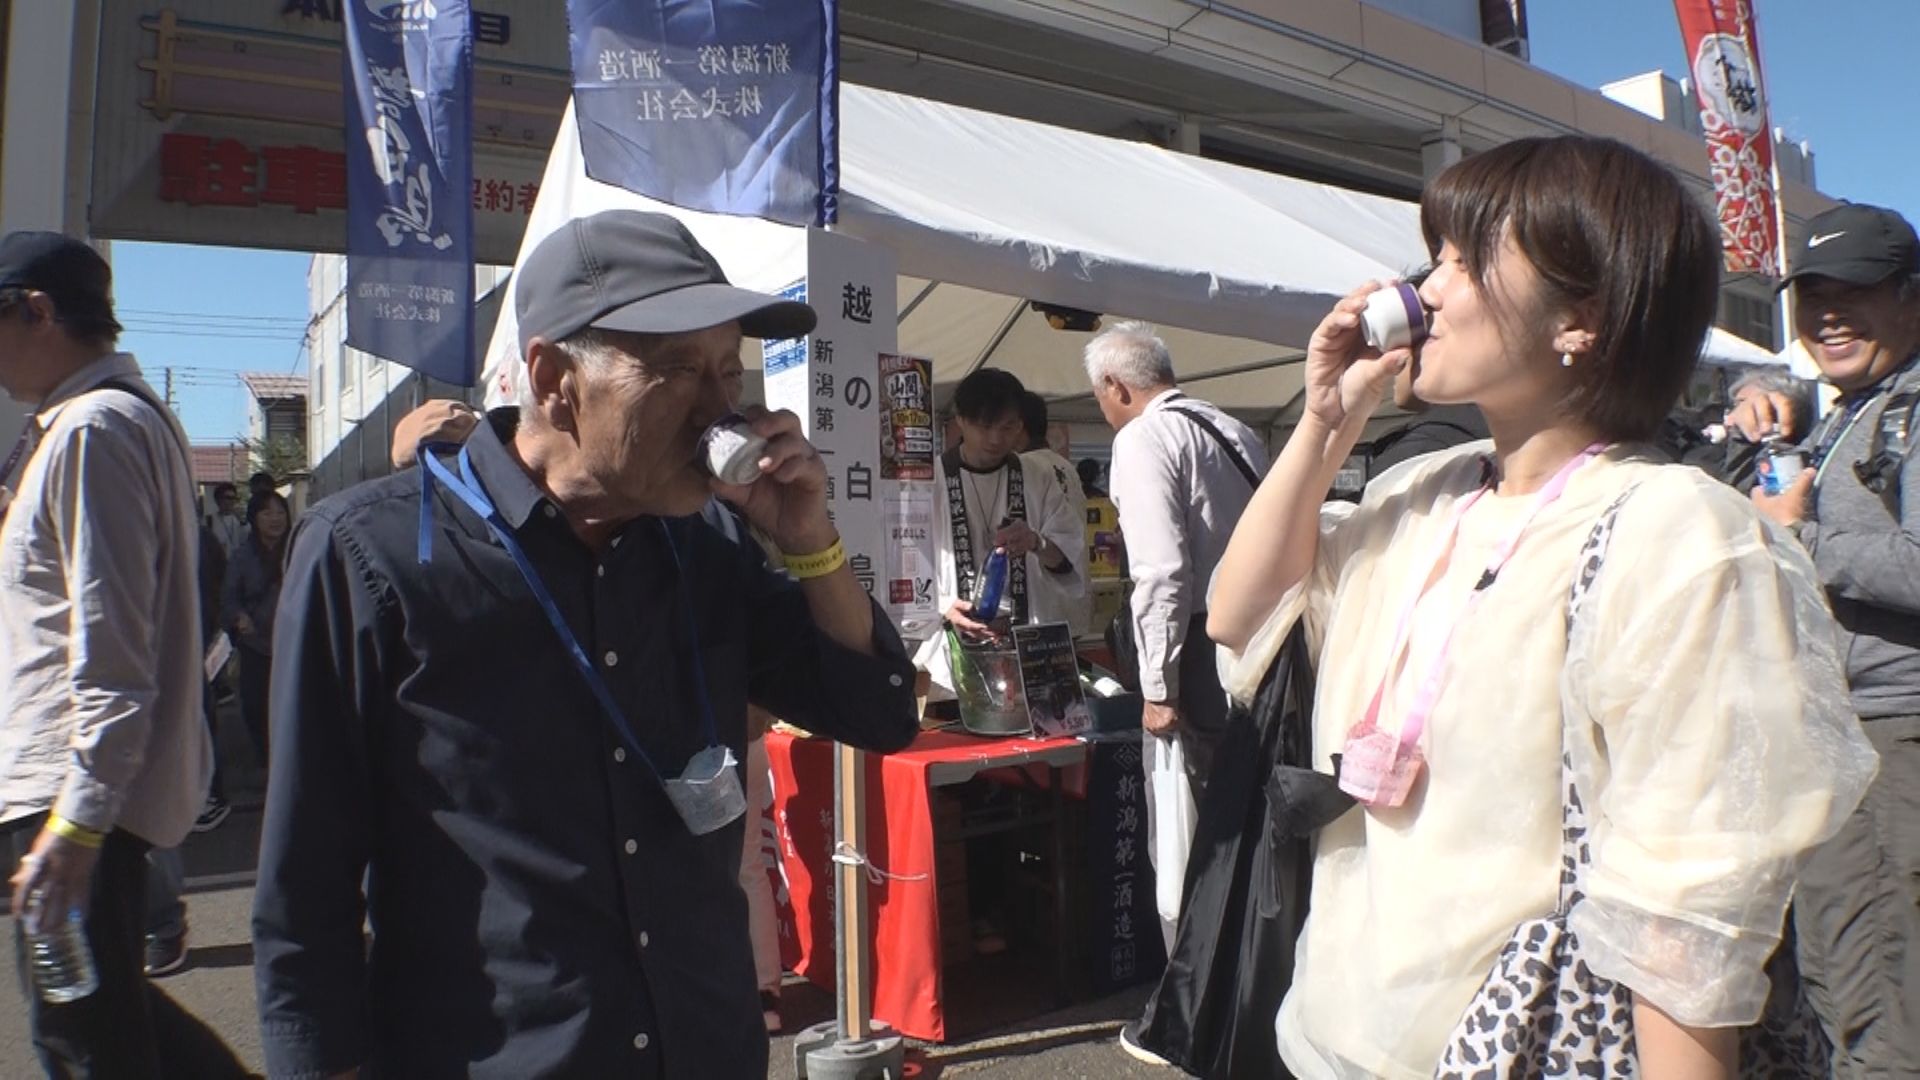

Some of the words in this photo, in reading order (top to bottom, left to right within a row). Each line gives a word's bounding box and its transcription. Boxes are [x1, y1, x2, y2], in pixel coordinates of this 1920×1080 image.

[1113, 774, 1139, 940] 新潟第一酒造
